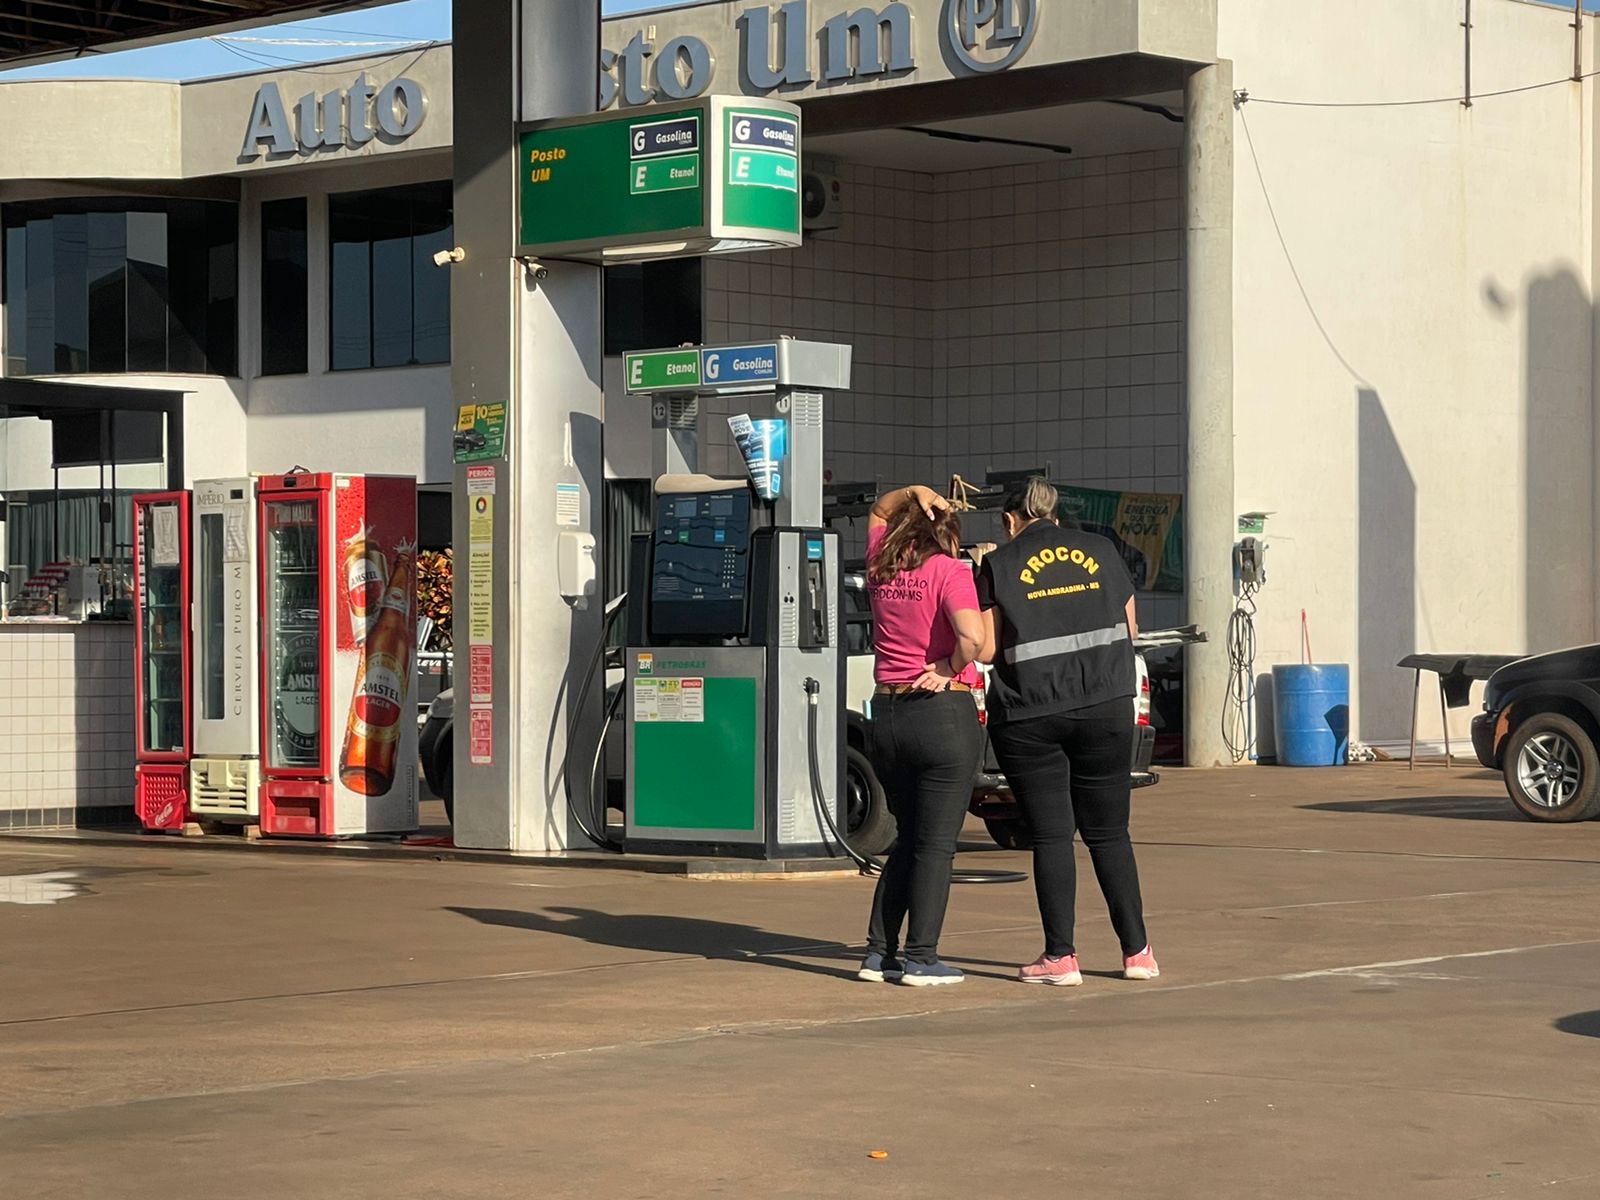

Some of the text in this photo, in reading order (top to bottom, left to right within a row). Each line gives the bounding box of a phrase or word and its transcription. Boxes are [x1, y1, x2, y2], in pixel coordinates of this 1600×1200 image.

[241, 71, 426, 157] Auto
[600, 30, 712, 109] sto
[634, 130, 692, 151] G Gasolina
[735, 120, 794, 142] G Gasolina
[530, 147, 567, 164] Posto
[530, 168, 551, 183] UM
[635, 166, 695, 188] E Etanol
[736, 156, 752, 178] E
[630, 359, 696, 385] E Etanol
[705, 354, 773, 379] G Gasolina
[476, 405, 488, 420] 10
[655, 406, 665, 416] 12
[1119, 522, 1161, 536] MOVE
[1019, 546, 1100, 585] PROCON
[1027, 589, 1047, 600] NOVA
[1047, 584, 1086, 596] ANDRADINA
[1089, 581, 1100, 590] MS
[234, 589, 242, 716] CERVEJA PURO
[287, 673, 319, 691] AMST
[360, 682, 400, 702] AMSTEL
[366, 697, 391, 709] LAGER
